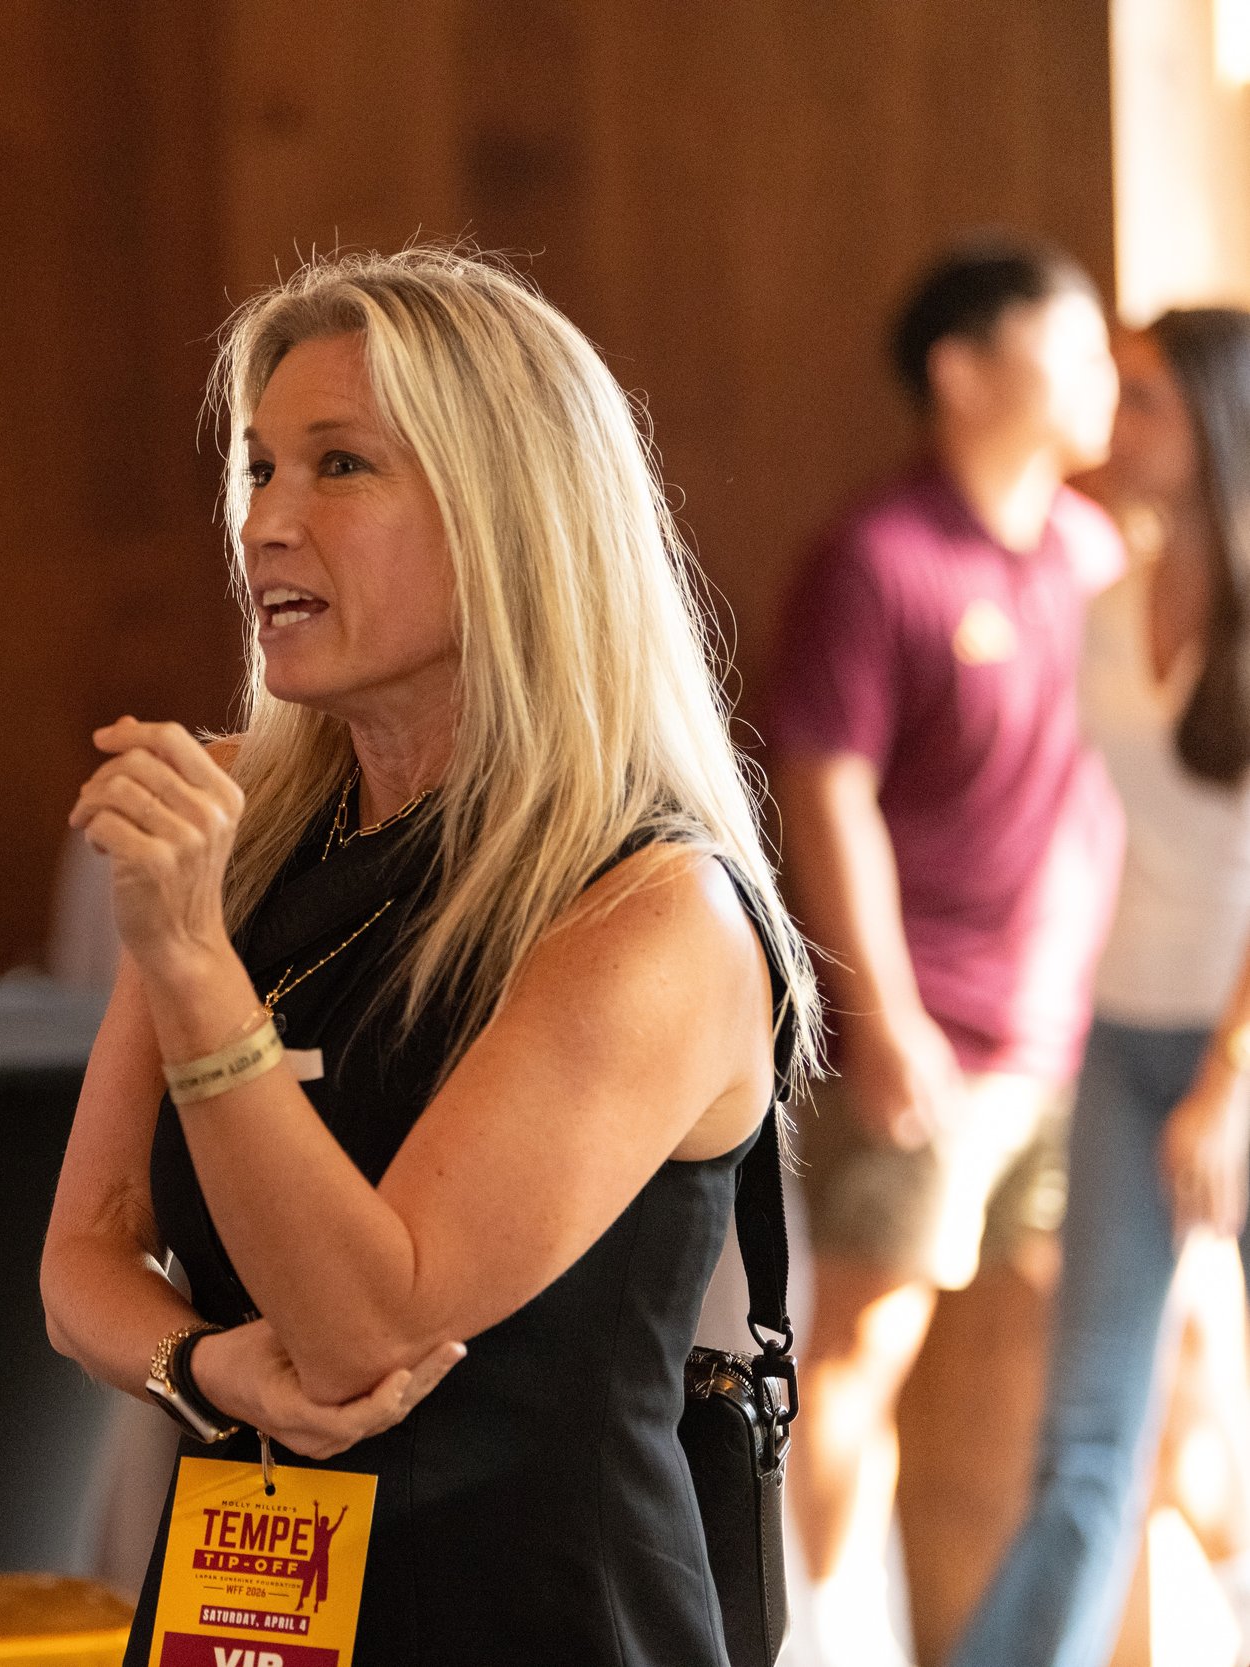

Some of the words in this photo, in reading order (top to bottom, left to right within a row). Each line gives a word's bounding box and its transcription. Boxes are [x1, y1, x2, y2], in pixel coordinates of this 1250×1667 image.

[255, 1503, 297, 1513] MILLER'S
[203, 1508, 312, 1556] TEMPE
[204, 1553, 299, 1575] TIP-OFF
[226, 1585, 245, 1595] WFF
[246, 1587, 266, 1598] 2026
[256, 1580, 301, 1589] FOUNDATION
[203, 1608, 259, 1628] SATURDAY,
[264, 1615, 295, 1631] APRIL
[299, 1619, 307, 1632] 4
